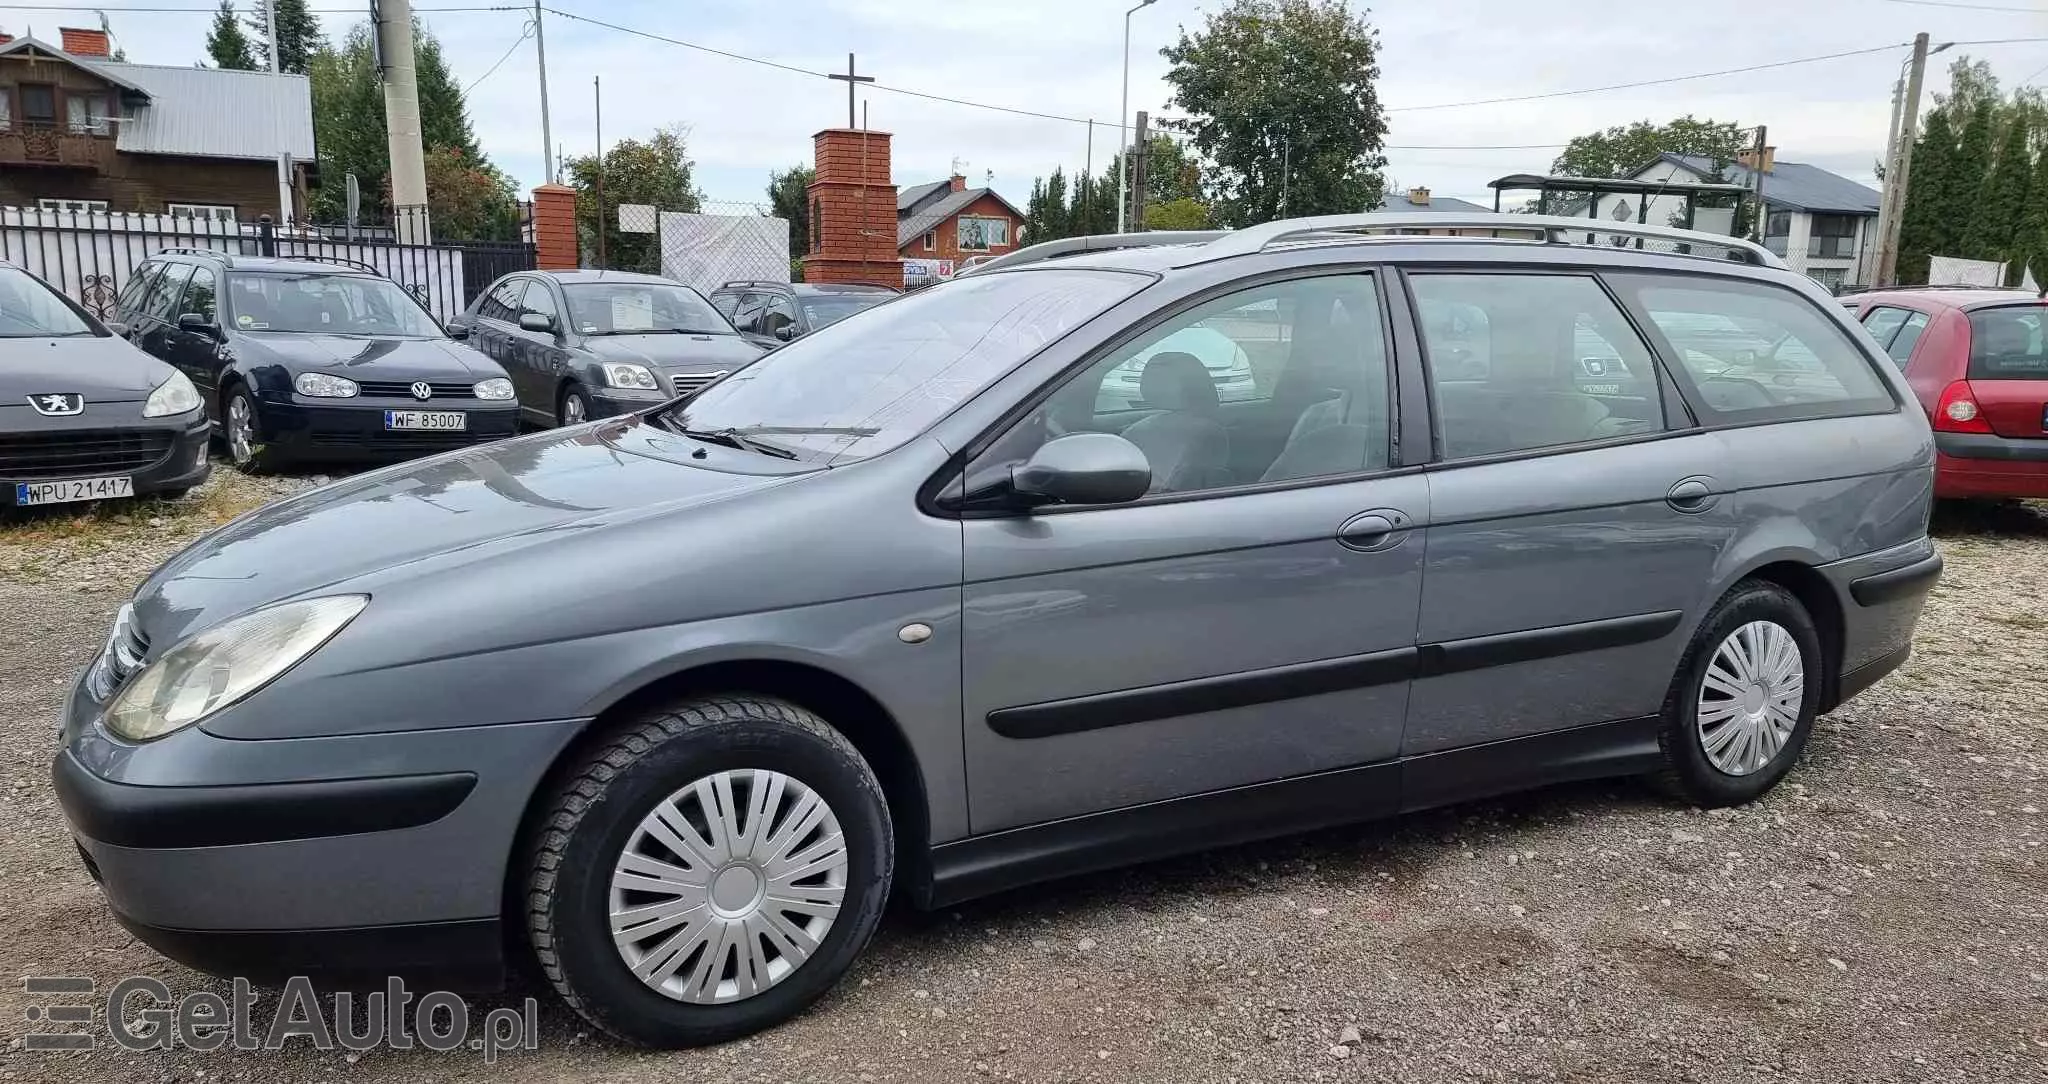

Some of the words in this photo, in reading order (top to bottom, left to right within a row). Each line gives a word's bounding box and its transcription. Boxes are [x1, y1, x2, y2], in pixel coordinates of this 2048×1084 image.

[394, 413, 415, 427] WF
[421, 414, 463, 428] 85007
[28, 484, 66, 503] WPU
[73, 478, 129, 499] 21417
